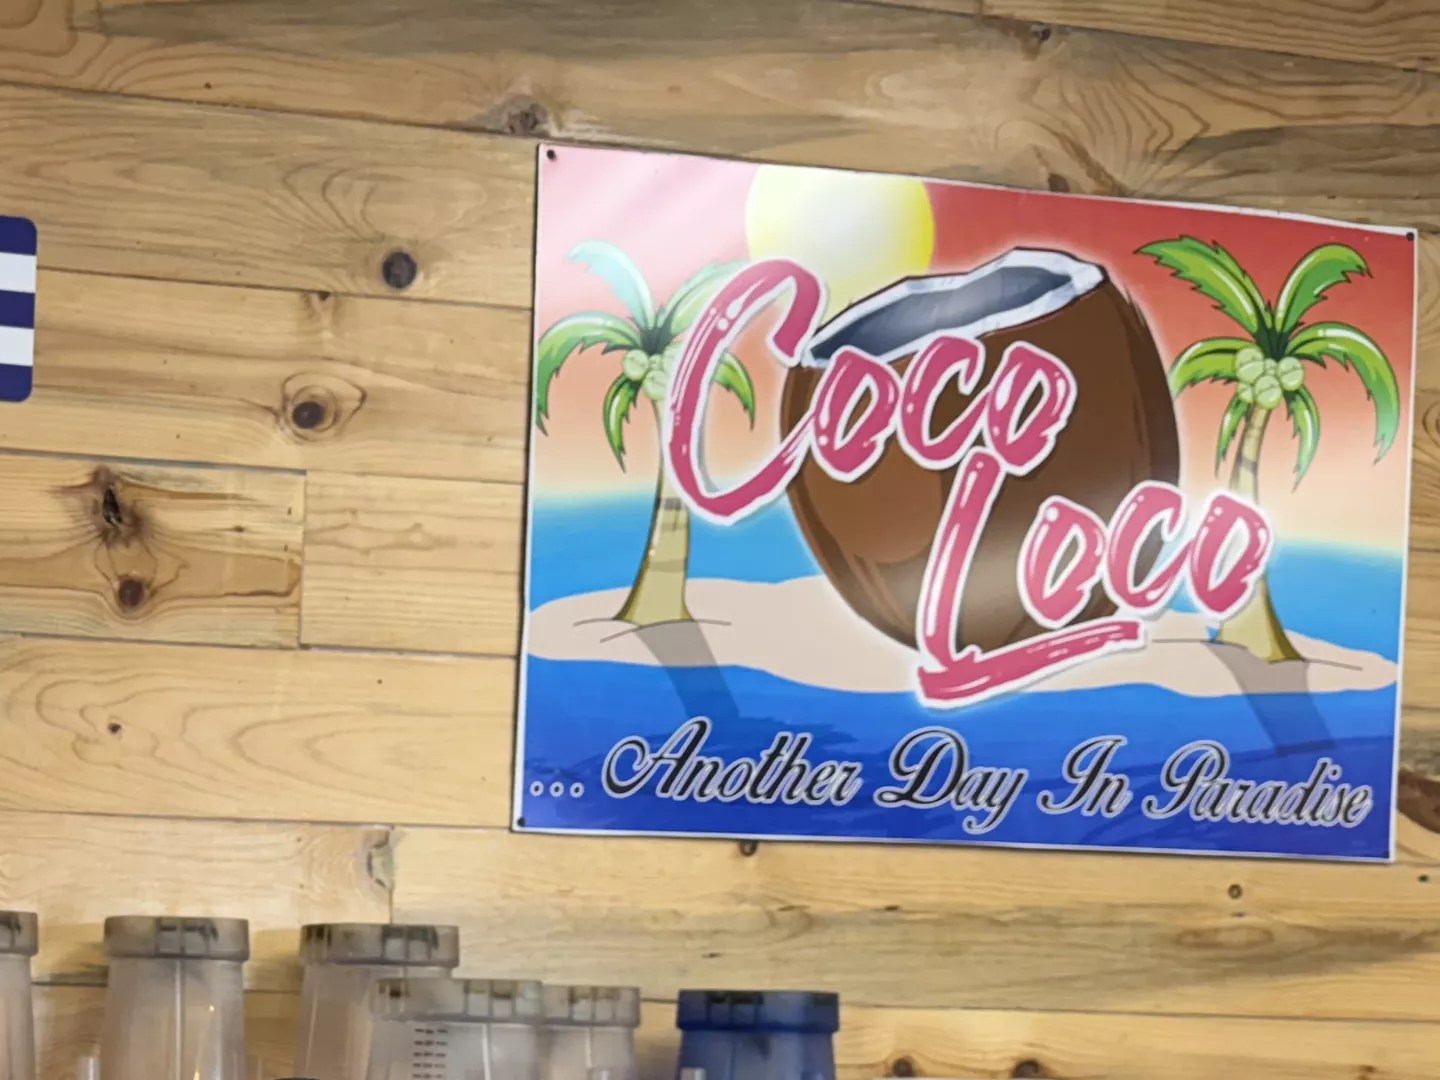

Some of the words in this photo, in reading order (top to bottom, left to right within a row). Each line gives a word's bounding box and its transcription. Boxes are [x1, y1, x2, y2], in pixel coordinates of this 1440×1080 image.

[665, 256, 1074, 522] Coco
[917, 451, 1273, 708] Loco
[601, 716, 864, 804] Another
[874, 725, 1029, 835] Day
[1036, 735, 1133, 817] In
[1143, 738, 1375, 828] Paradise
